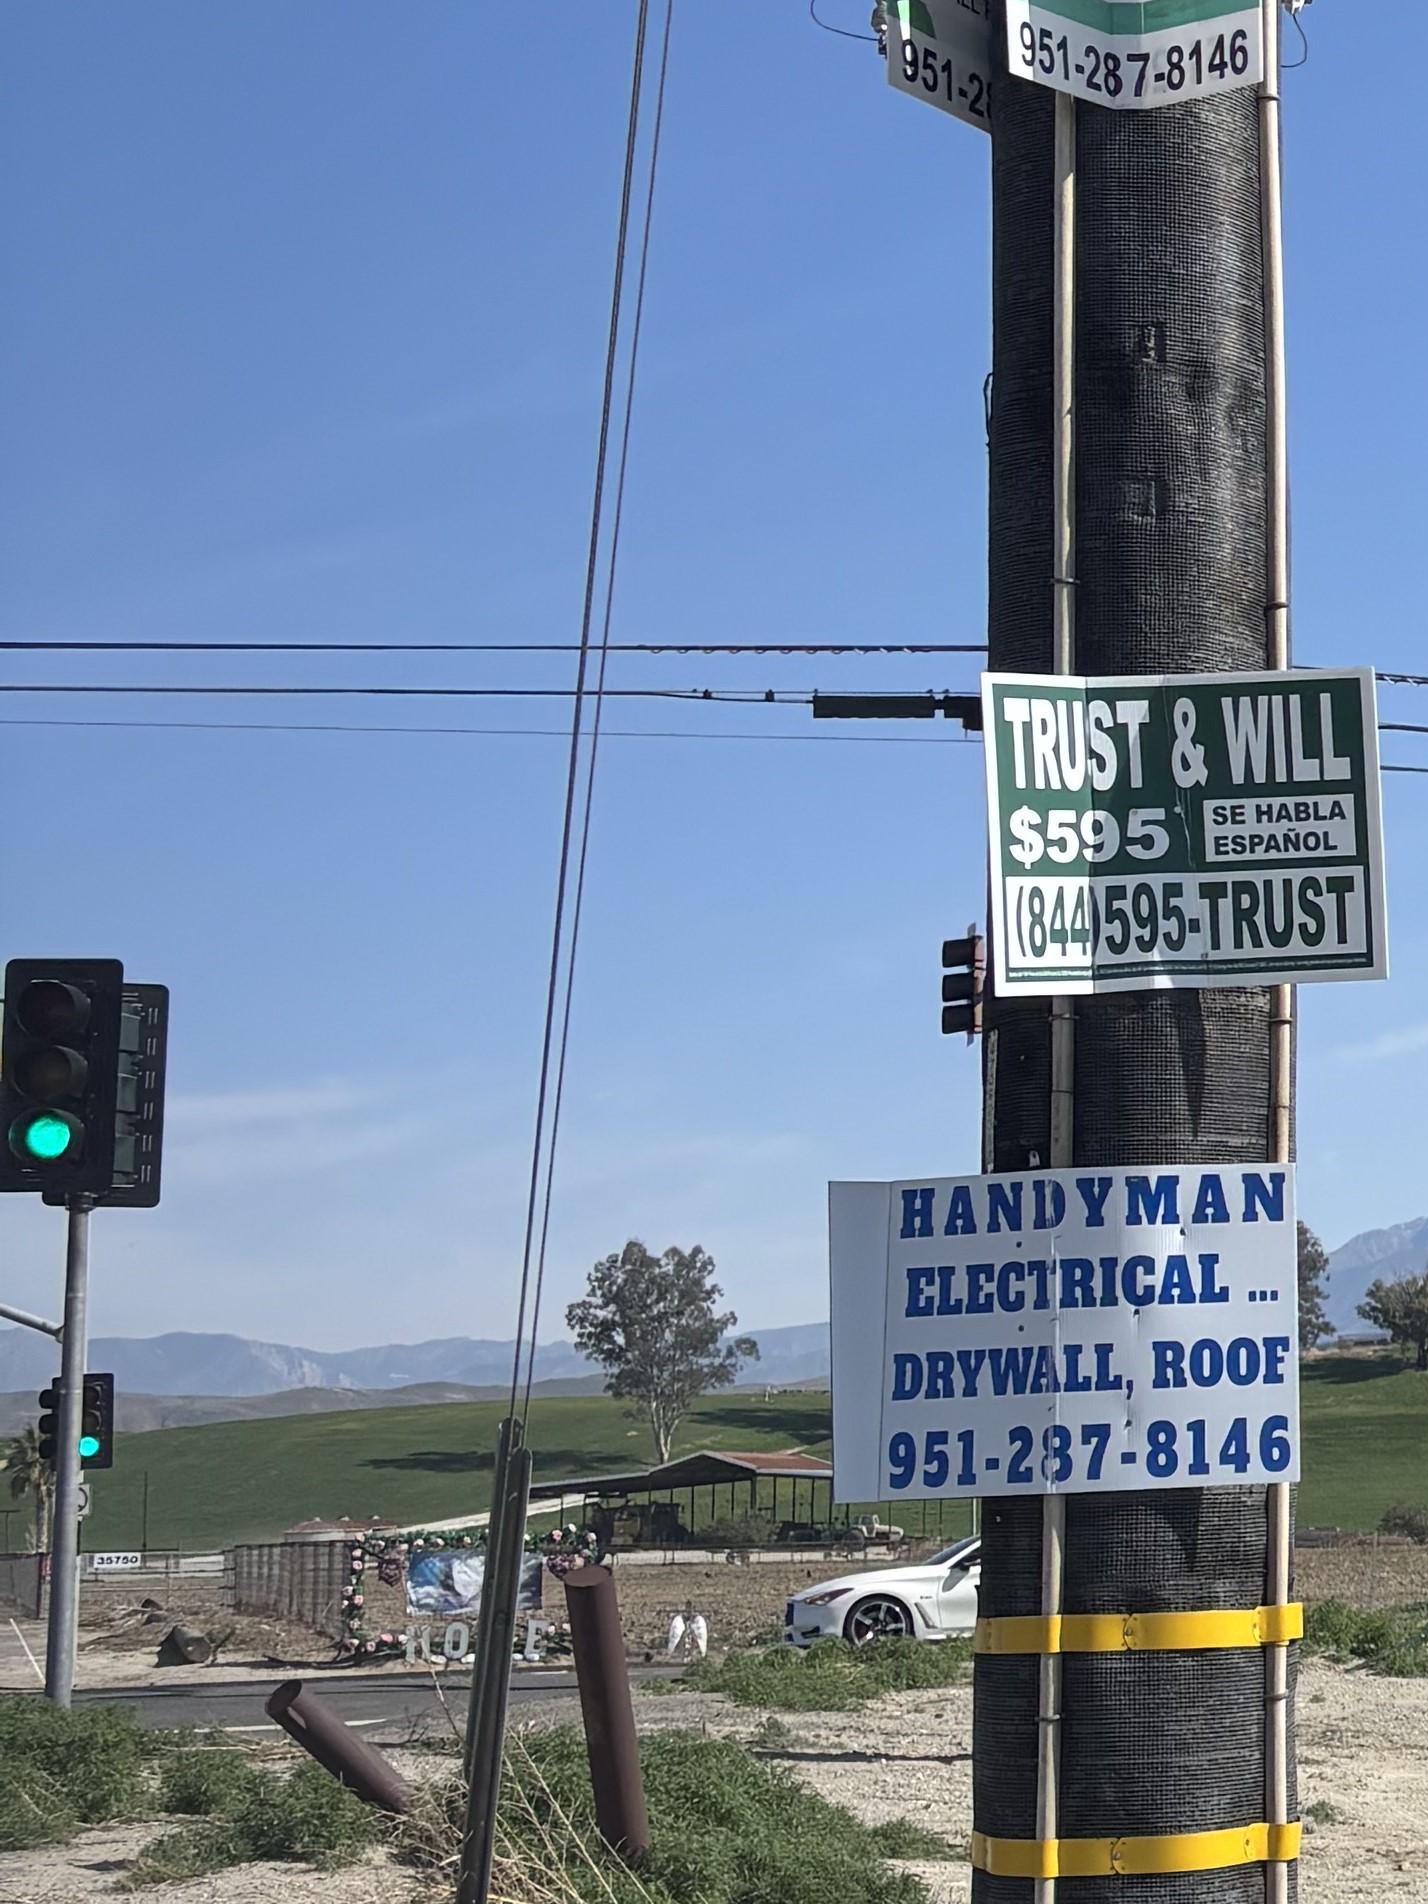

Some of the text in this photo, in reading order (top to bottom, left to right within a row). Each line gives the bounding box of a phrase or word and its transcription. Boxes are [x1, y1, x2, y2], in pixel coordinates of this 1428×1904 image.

[1020, 21, 1249, 98] 951-287-8146
[1002, 693, 1352, 793] TRUST & WILL
[1009, 805, 1171, 869] $595
[1212, 800, 1346, 826] SE HABLA
[1213, 826, 1339, 856] ESPAÑOL
[900, 1172, 1286, 1239] HANDYMAN
[904, 1253, 1229, 1318] ELECTRICAL
[892, 1336, 1290, 1401] DRYWALL, ROOF
[888, 1415, 1292, 1490] 951-287-8146
